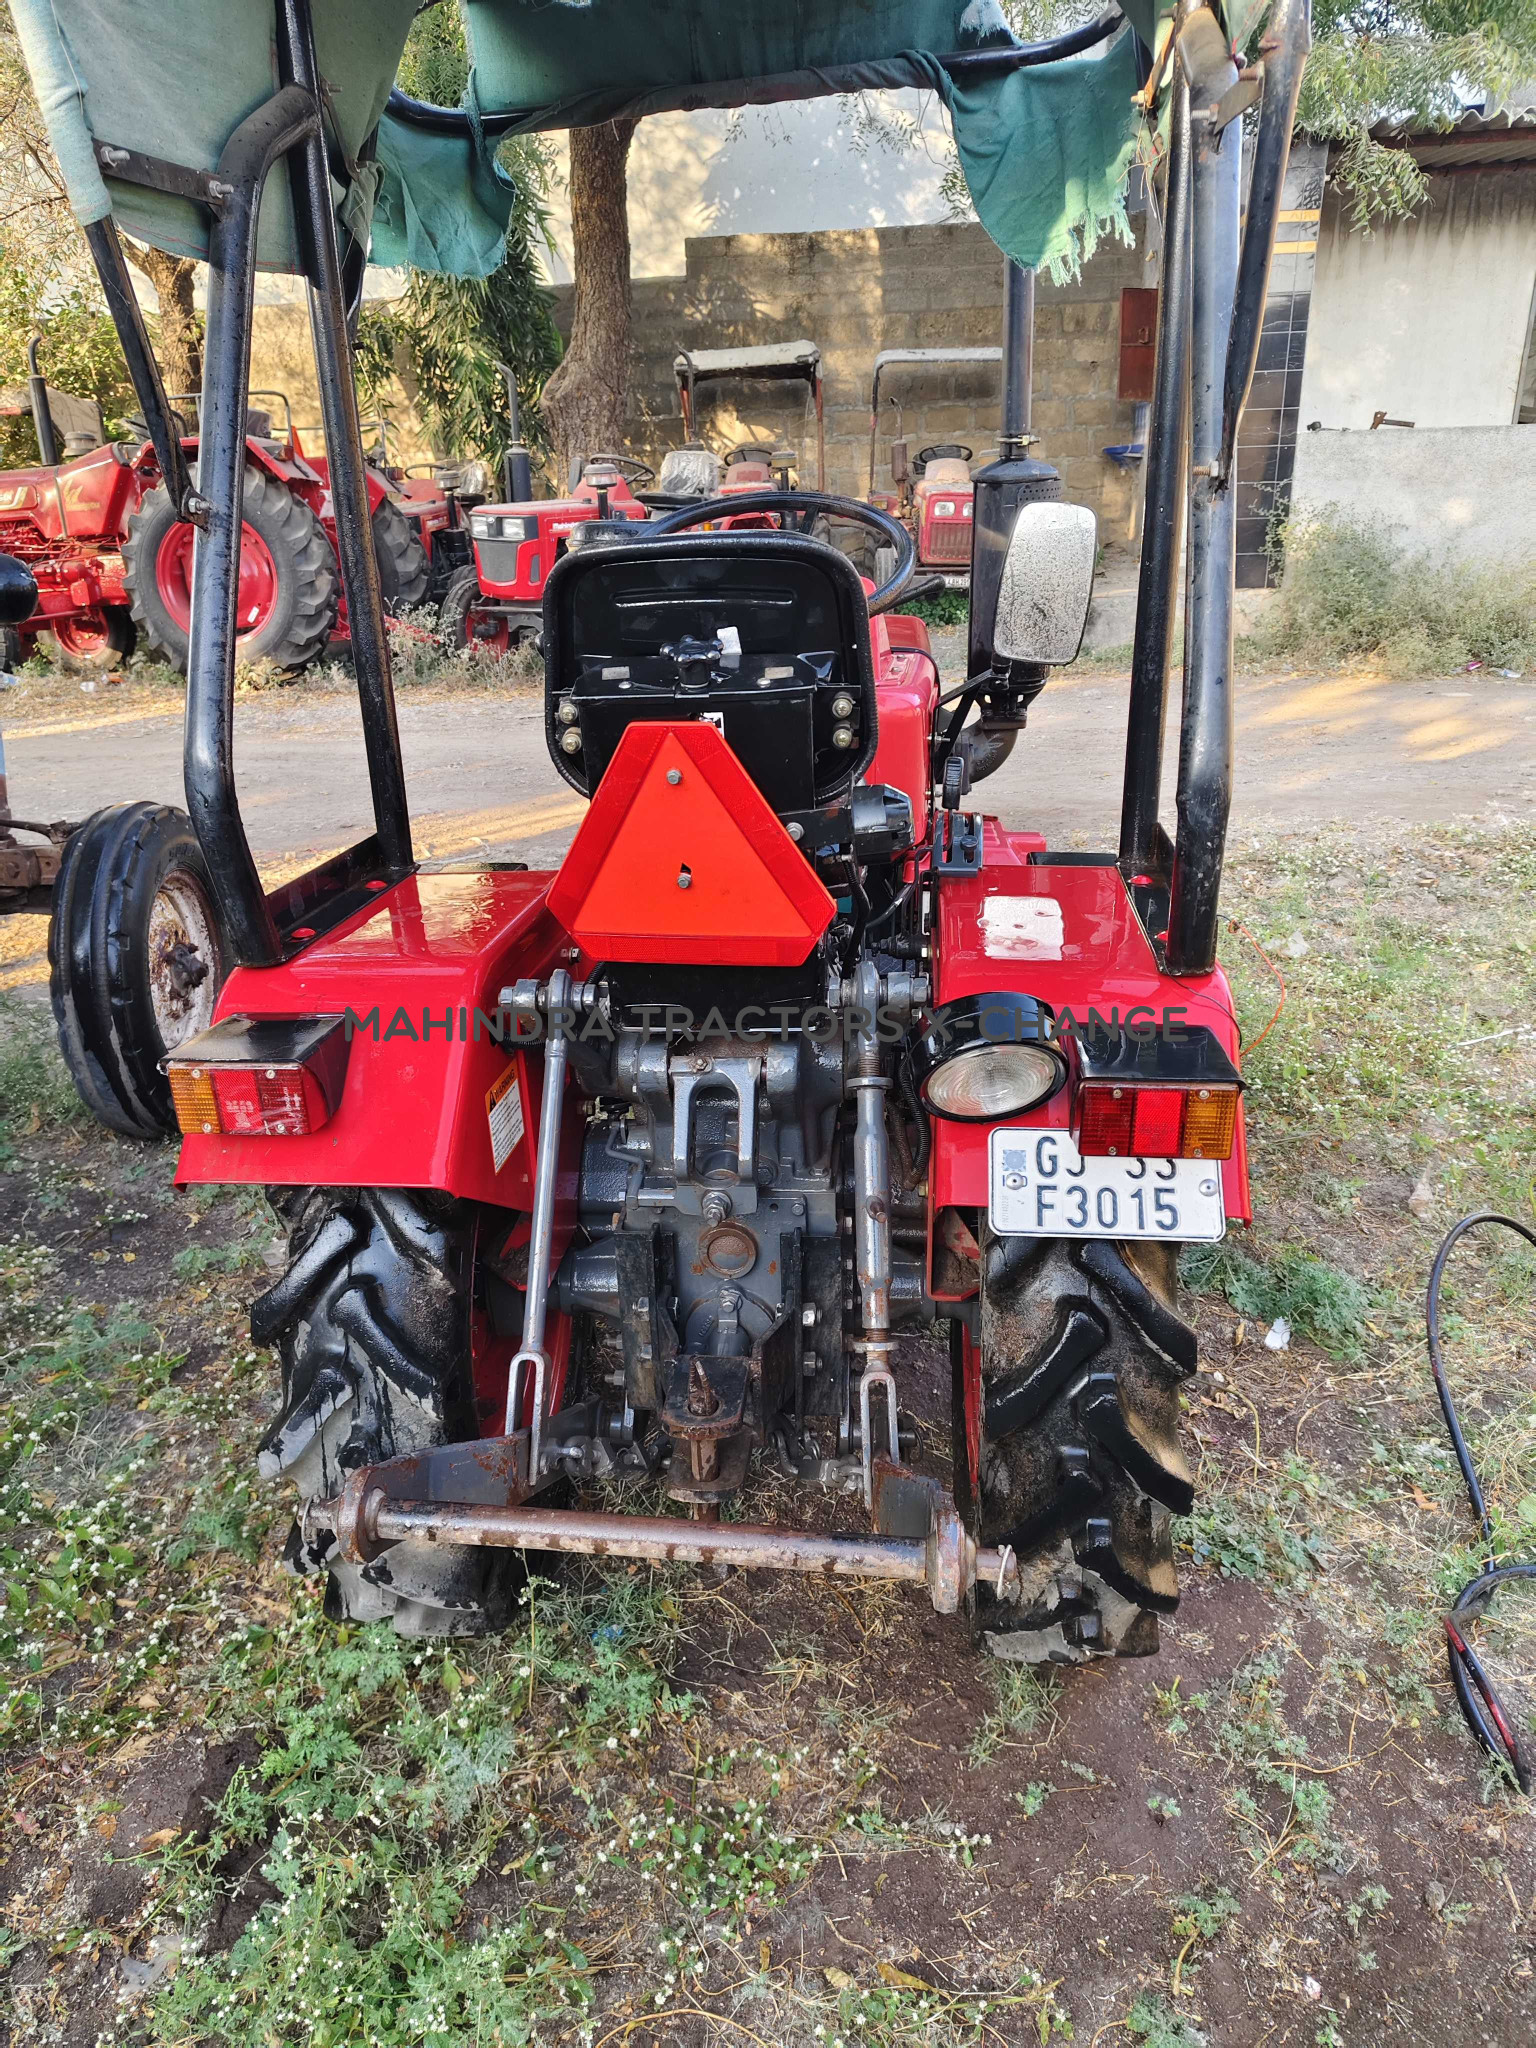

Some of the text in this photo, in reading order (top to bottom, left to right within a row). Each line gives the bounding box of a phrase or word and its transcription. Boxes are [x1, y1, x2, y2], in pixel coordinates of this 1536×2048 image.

[494, 1068, 515, 1099] WARNING
[1036, 1136, 1085, 1178] GJ
[1036, 1185, 1179, 1231] F3015
